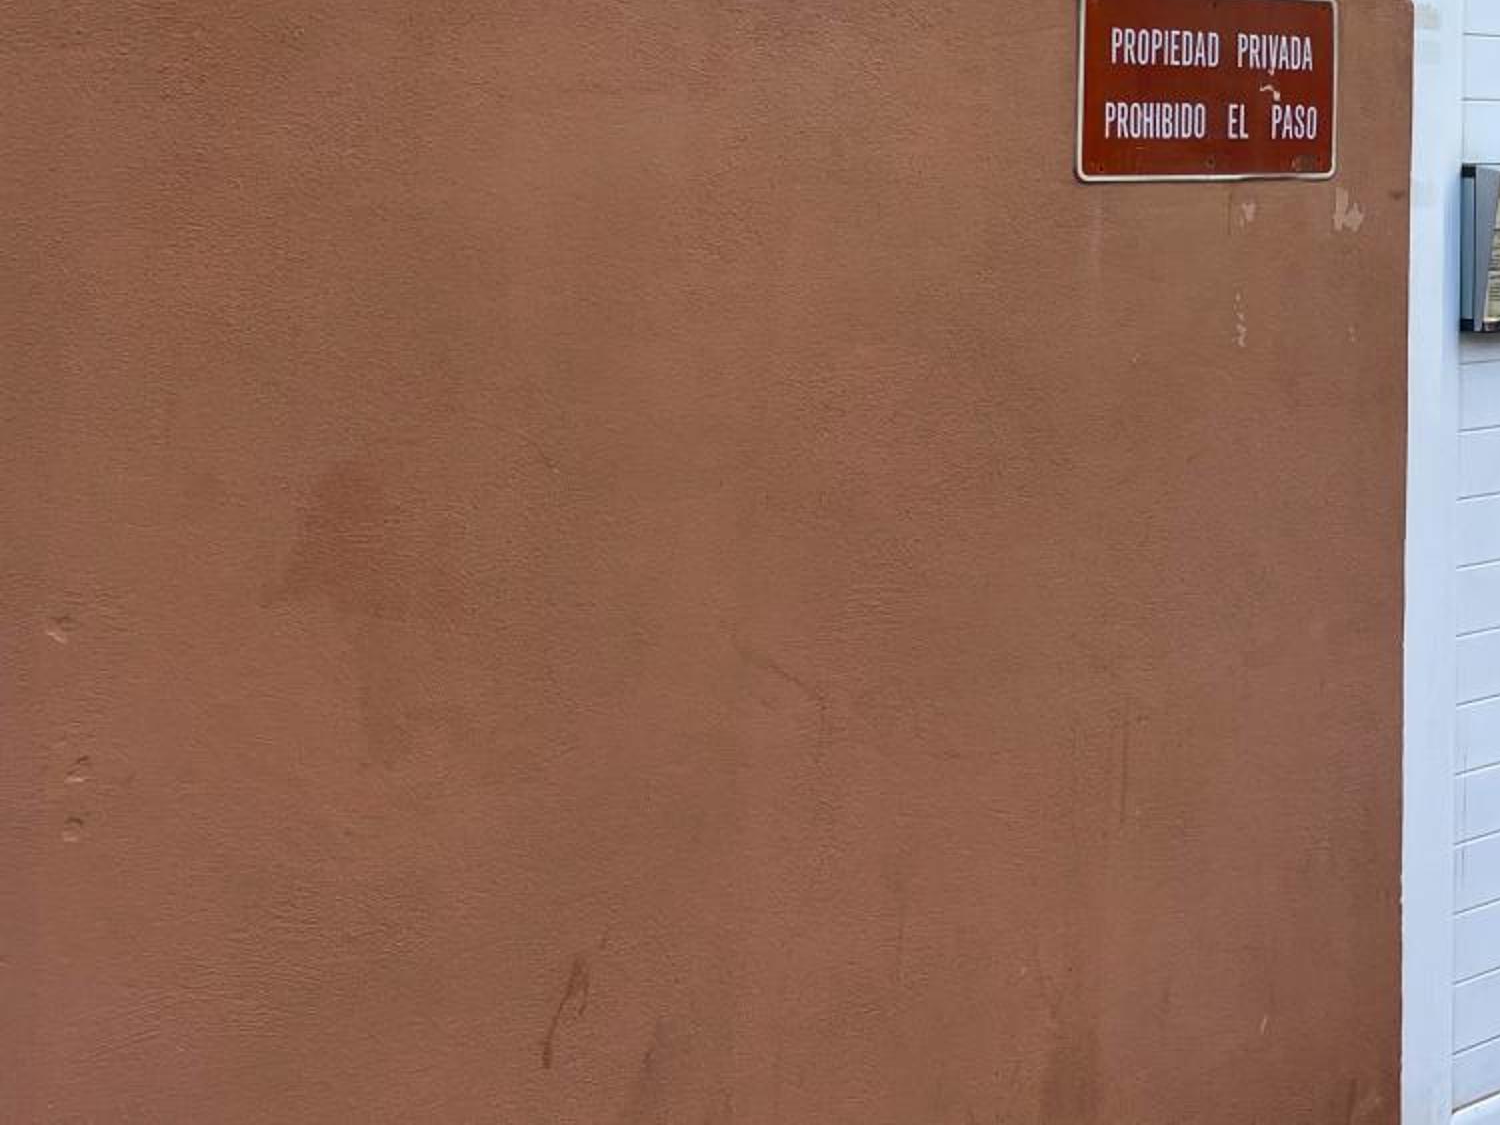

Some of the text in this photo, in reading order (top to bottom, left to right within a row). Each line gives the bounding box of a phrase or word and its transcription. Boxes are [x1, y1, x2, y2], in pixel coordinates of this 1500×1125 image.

[1111, 26, 1314, 72] PROPIEDAD PRIVADA
[1104, 101, 1318, 140] PROHIBIDO EL PASO
